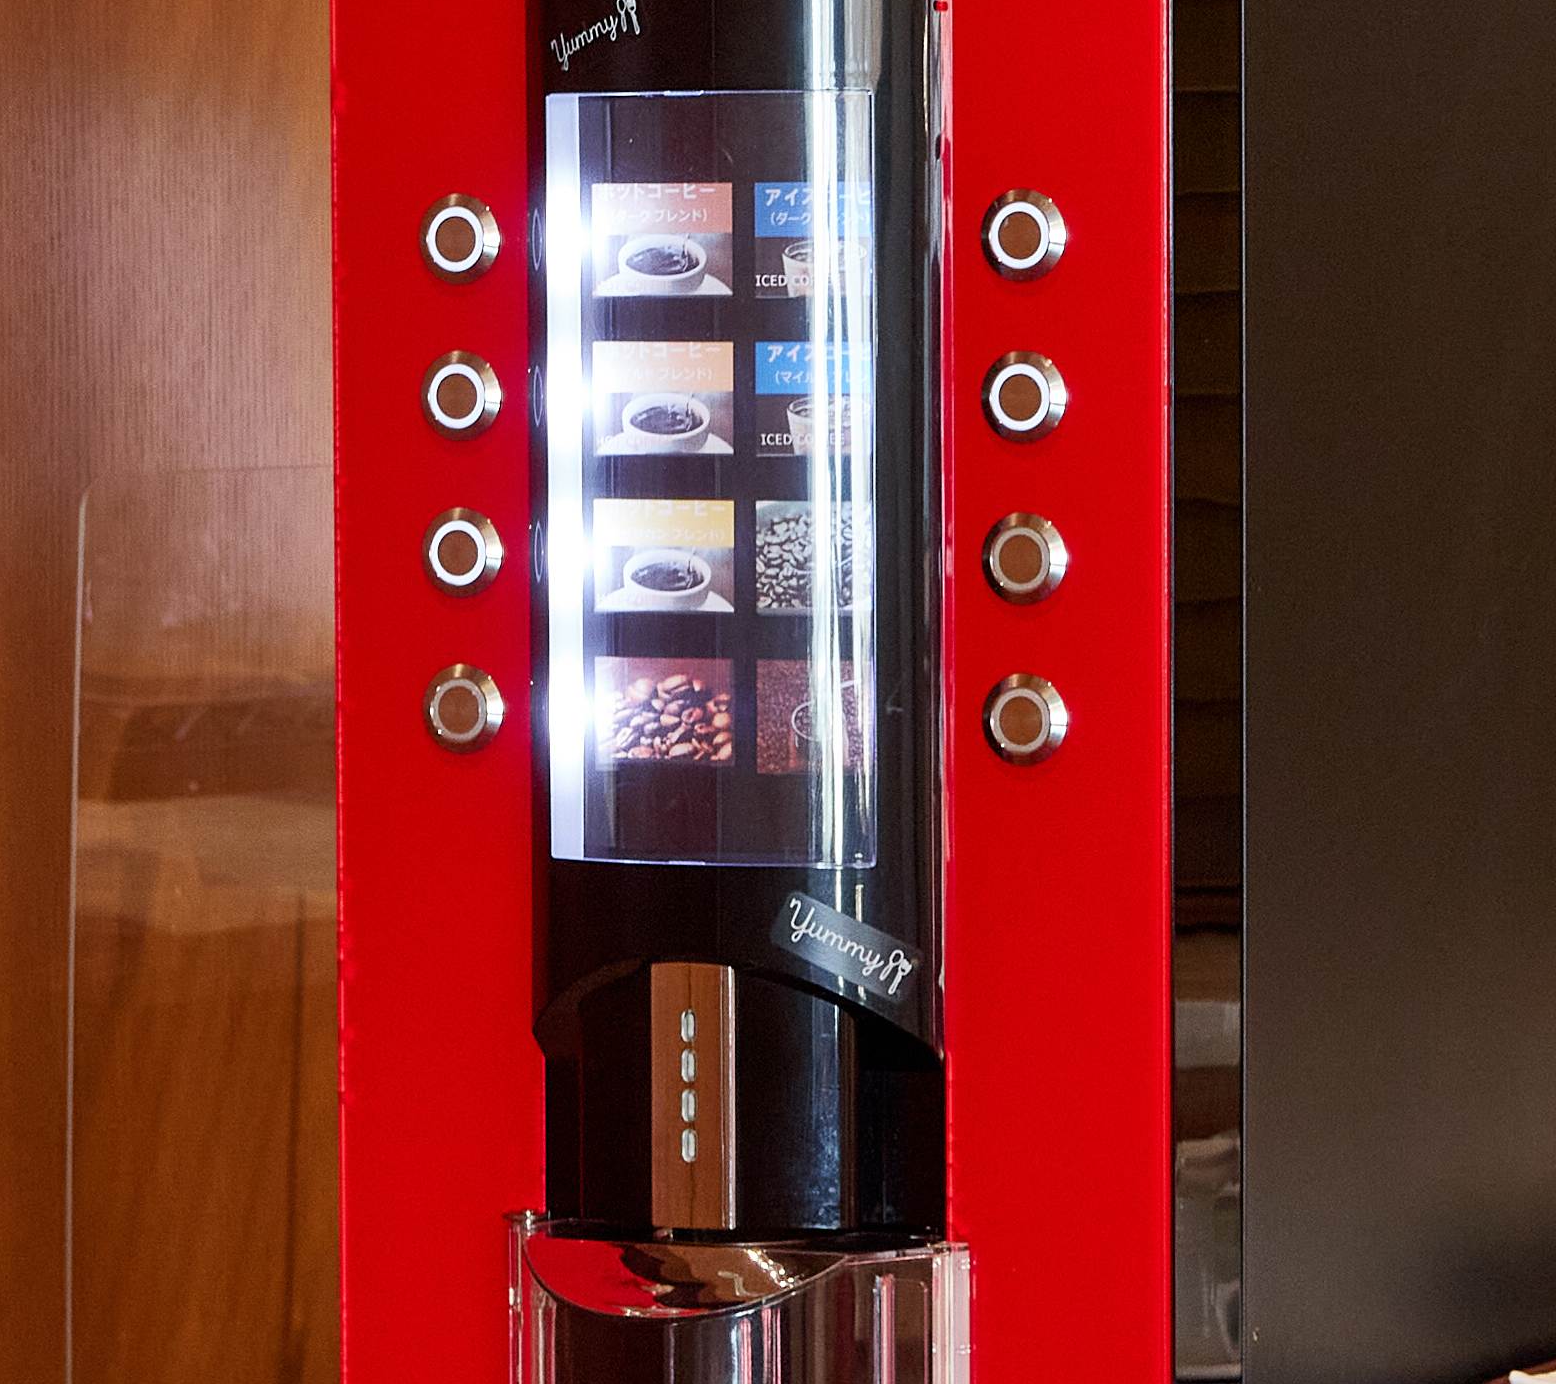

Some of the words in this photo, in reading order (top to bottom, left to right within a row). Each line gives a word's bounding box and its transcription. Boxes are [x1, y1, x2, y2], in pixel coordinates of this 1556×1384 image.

[550, 15, 618, 71] Yummy
[755, 274, 787, 288] ICED
[760, 433, 793, 447] ICED
[790, 898, 884, 976] Yummy
